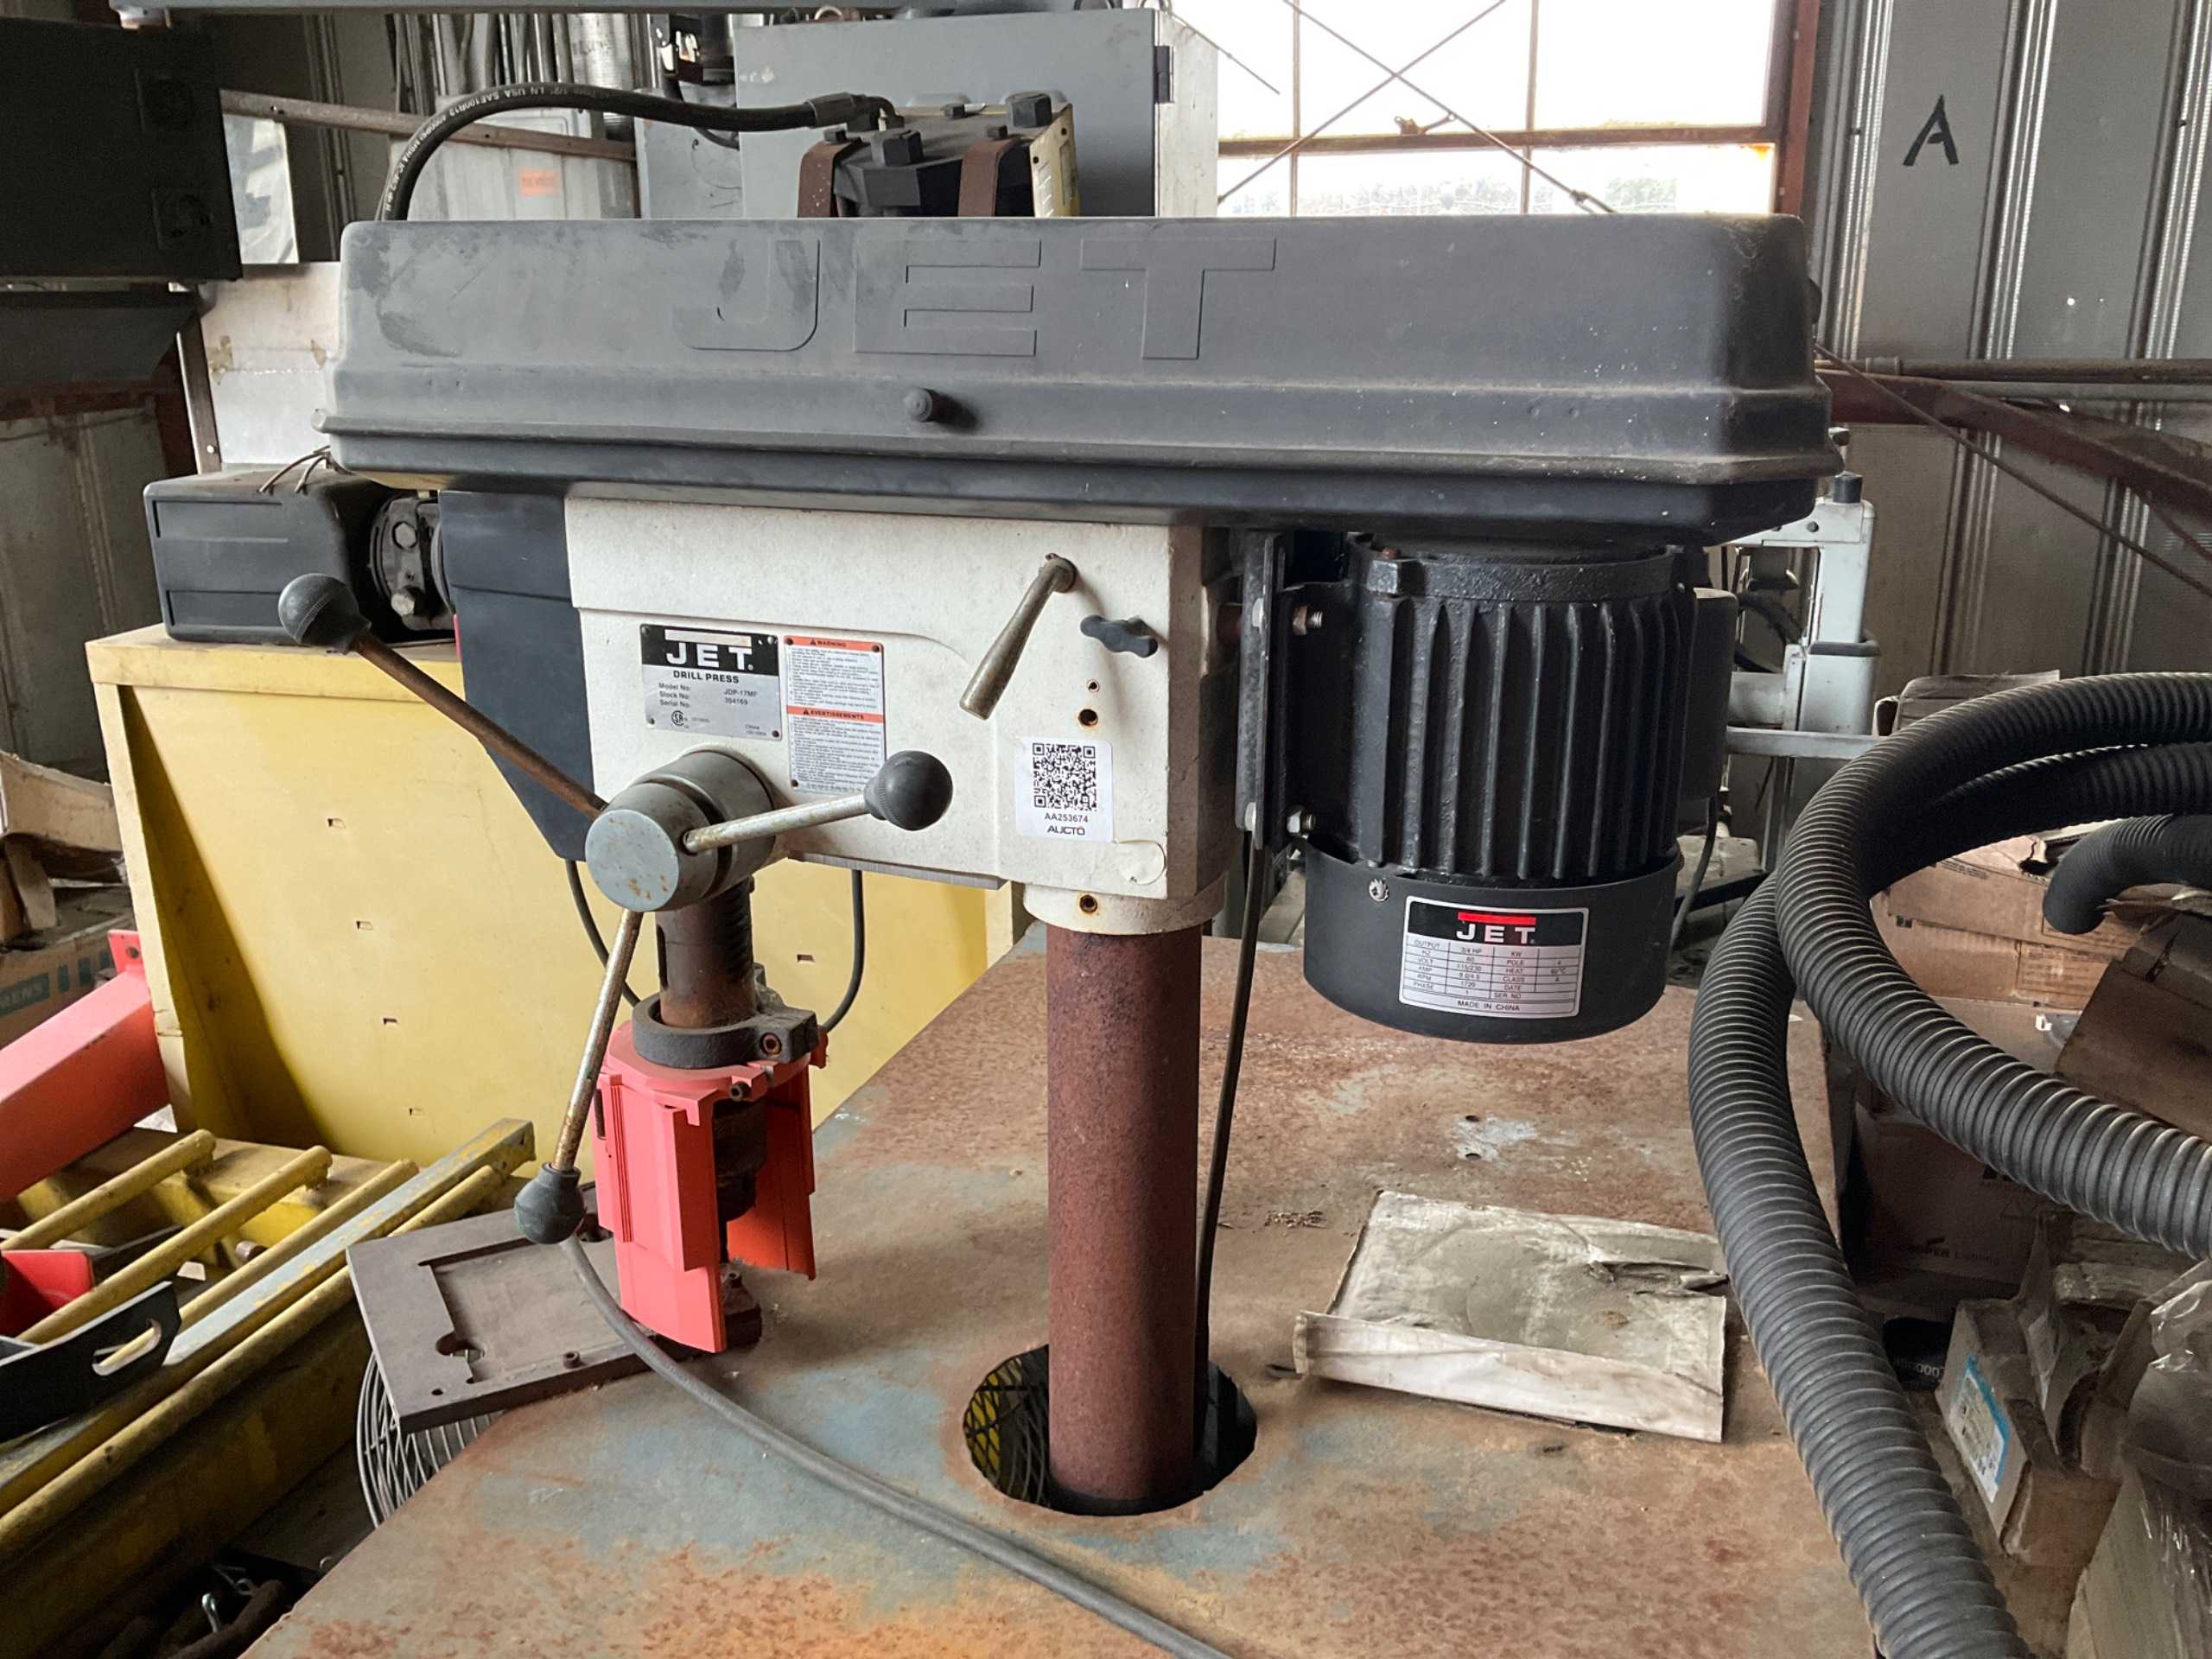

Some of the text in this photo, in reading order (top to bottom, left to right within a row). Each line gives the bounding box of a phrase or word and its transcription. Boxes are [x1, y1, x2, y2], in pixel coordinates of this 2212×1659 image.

[505, 88, 525, 97] USA
[1903, 94, 1959, 166] A
[672, 238, 1277, 360] JET
[666, 642, 753, 671] JET
[673, 670, 740, 683] DRILL PRESS
[1045, 813, 1089, 823] AA253674
[1456, 924, 1535, 944] JET
[1458, 1000, 1479, 1009] MADE
